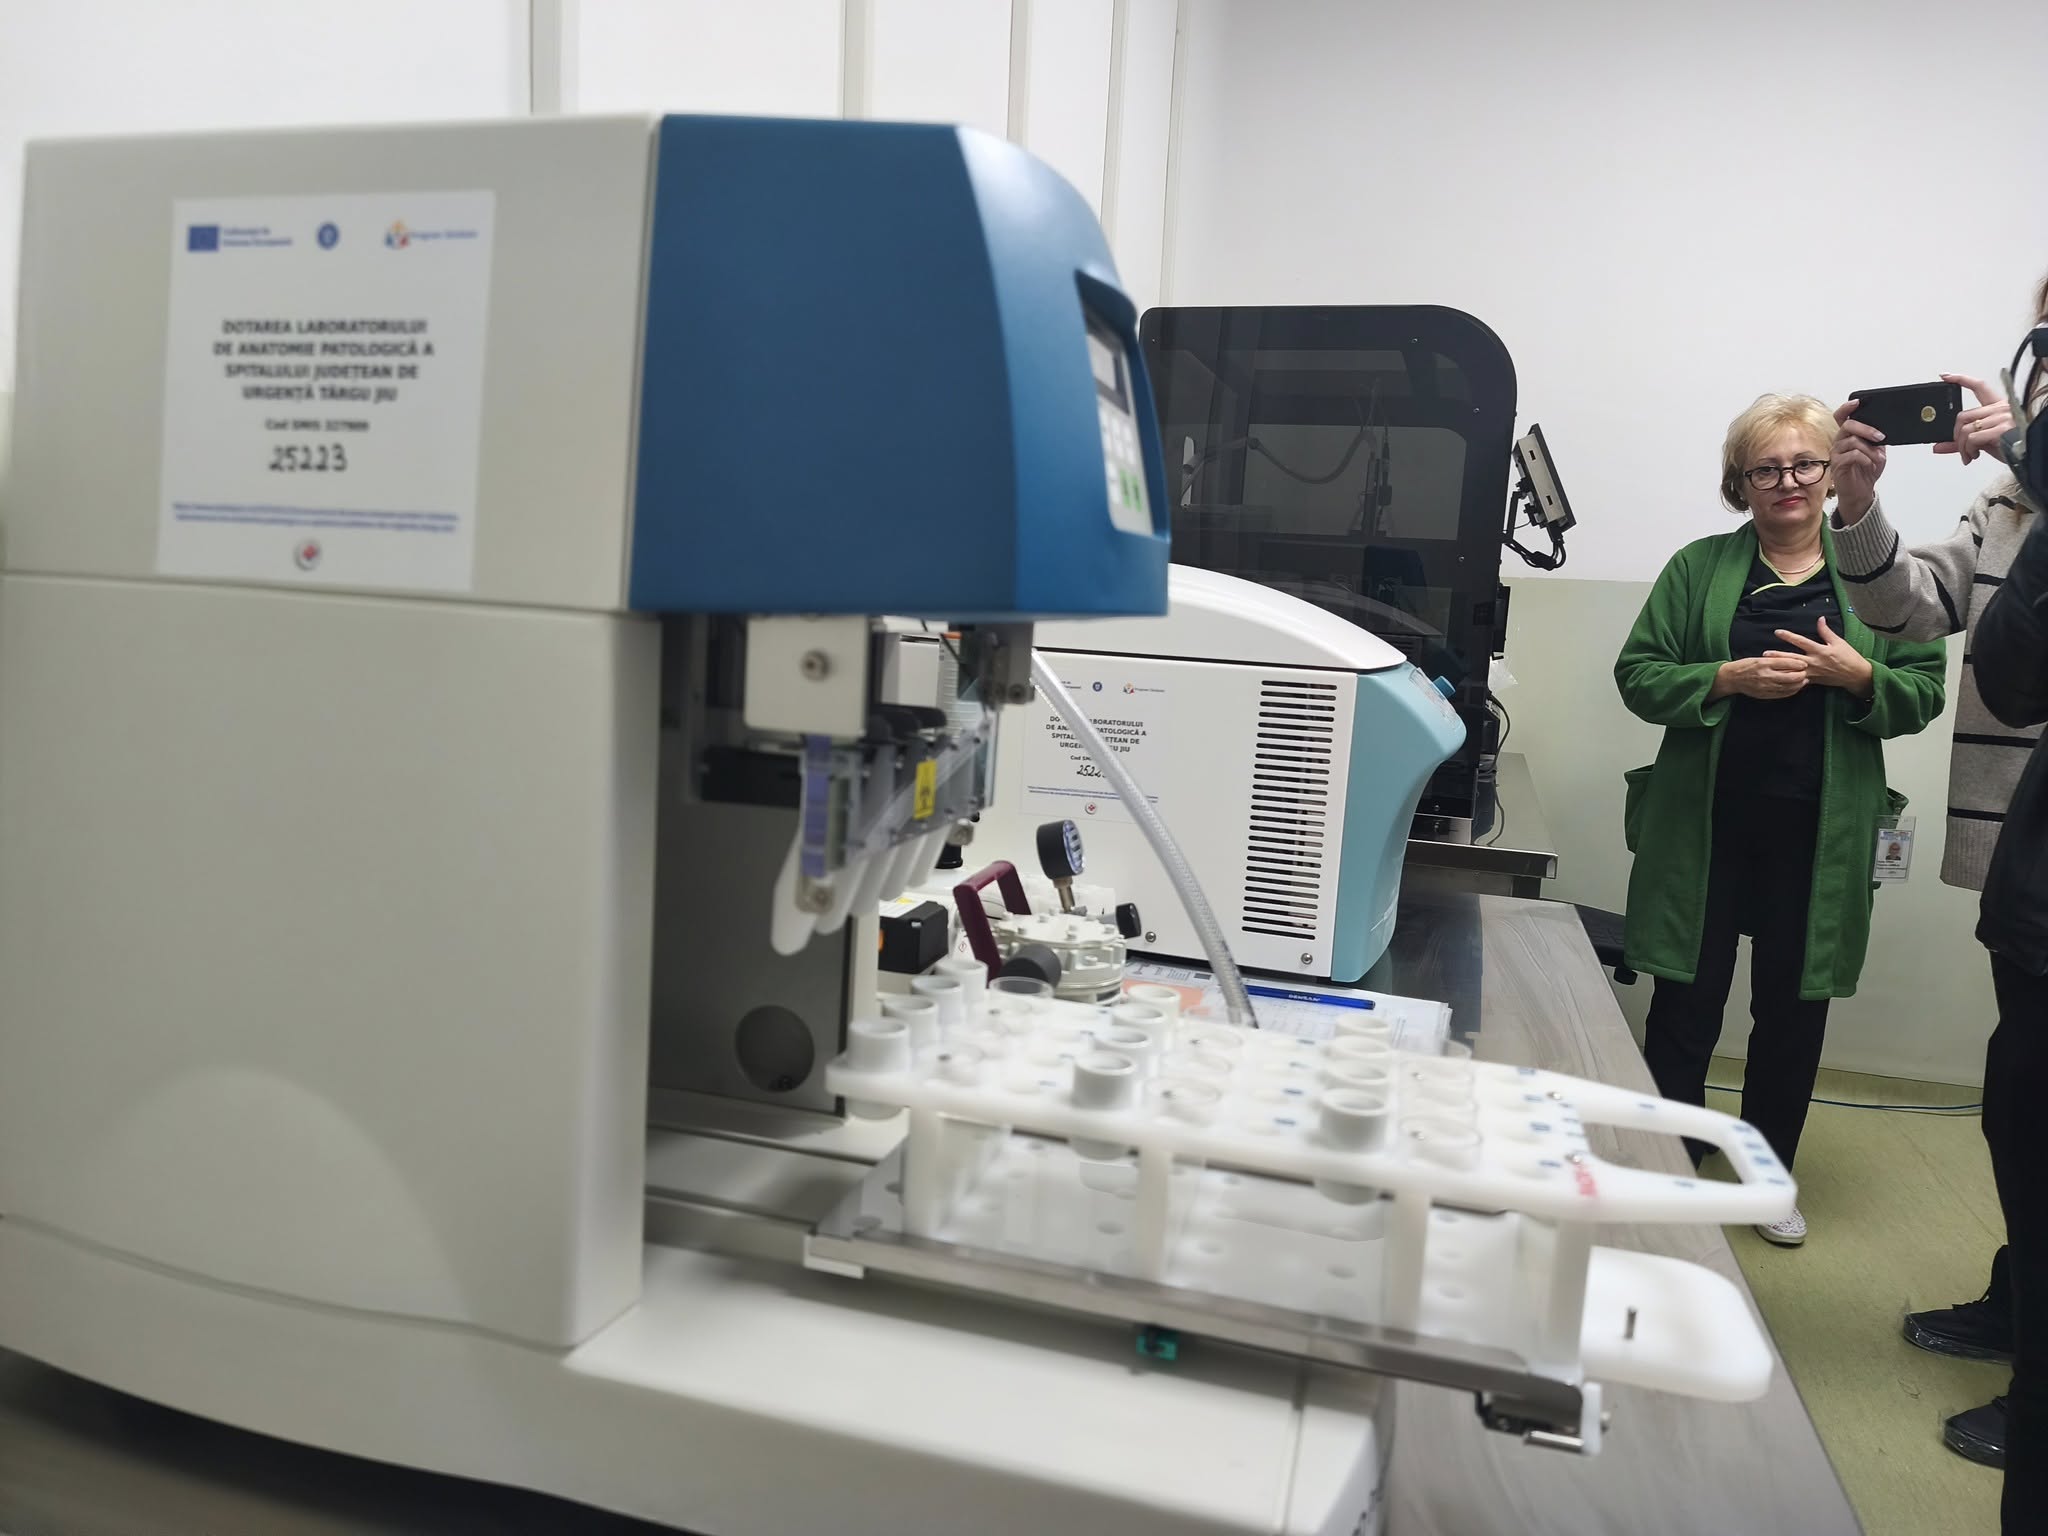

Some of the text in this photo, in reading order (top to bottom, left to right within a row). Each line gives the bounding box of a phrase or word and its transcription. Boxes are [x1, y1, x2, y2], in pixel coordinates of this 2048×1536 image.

[222, 319, 428, 335] DOTAREA LABORATORULUI
[213, 341, 233, 356] DE
[238, 341, 315, 357] ANATOMIE
[422, 342, 436, 357] A
[396, 364, 419, 380] DE
[1051, 732, 1077, 740] SPITAL
